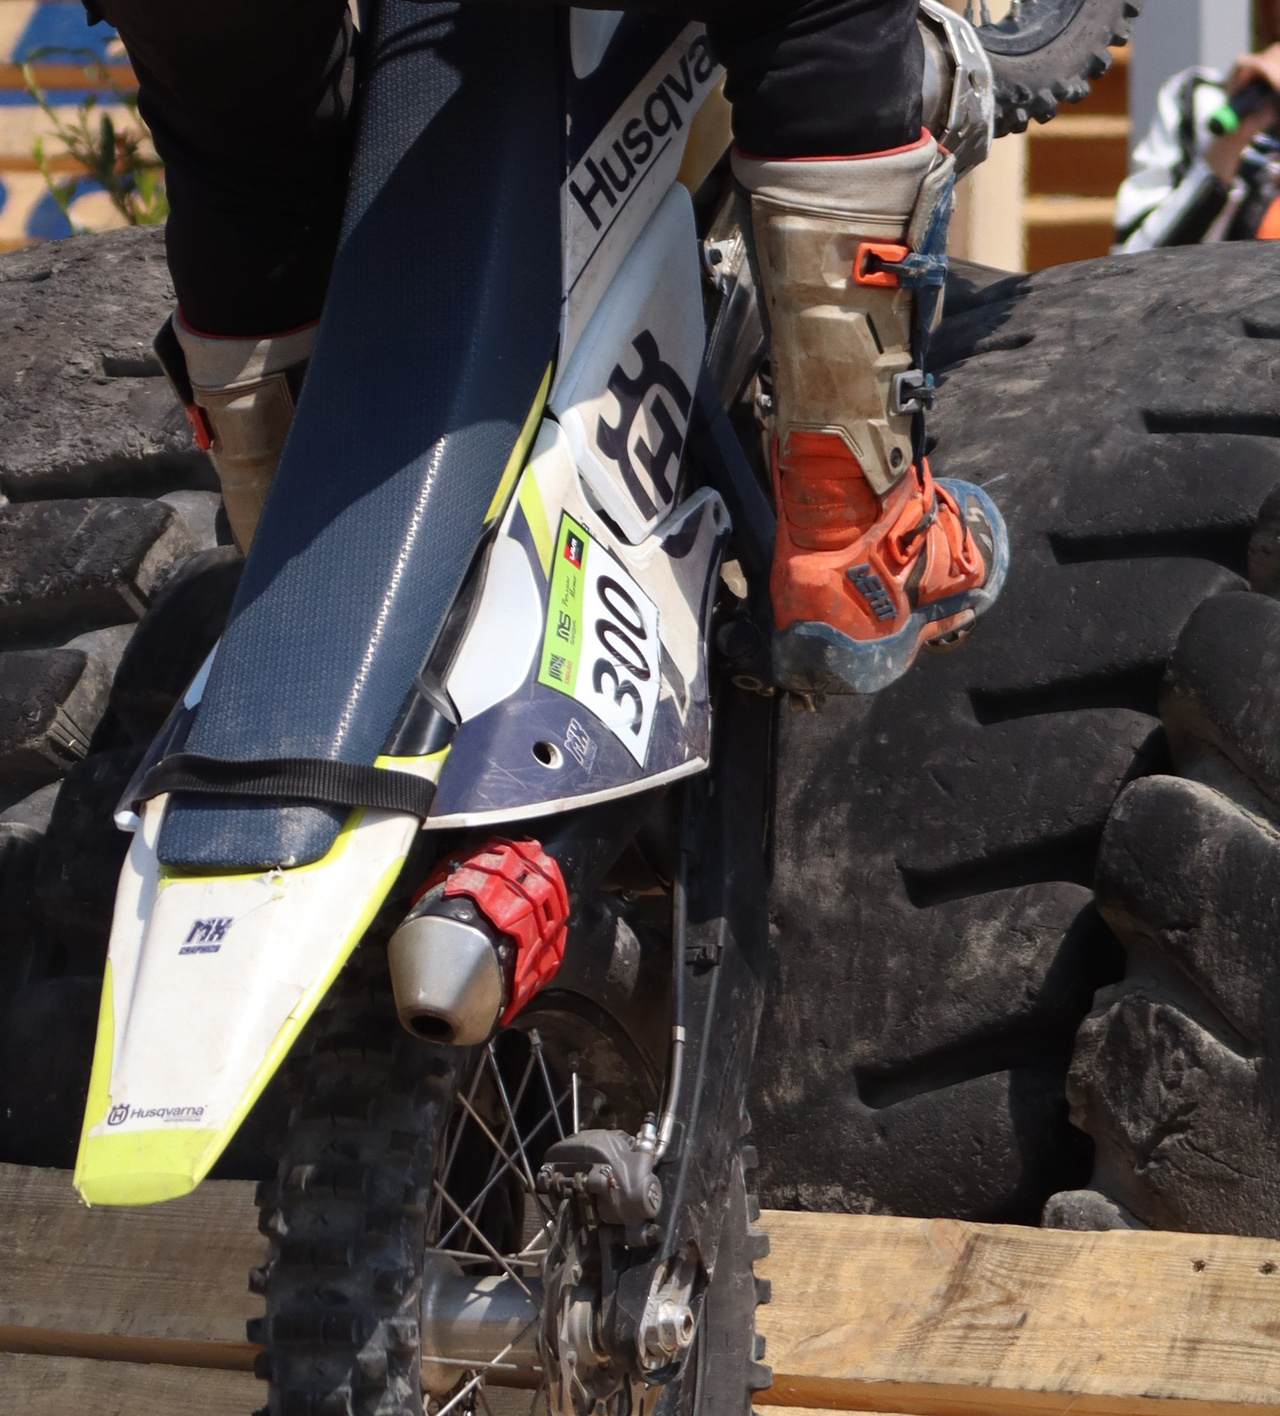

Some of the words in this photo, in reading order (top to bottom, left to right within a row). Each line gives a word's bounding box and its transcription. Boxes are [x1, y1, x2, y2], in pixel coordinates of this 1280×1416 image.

[569, 34, 717, 231] Husqva
[592, 574, 651, 735] 300
[183, 917, 235, 945] MX
[130, 1105, 205, 1118] Husqvarna
